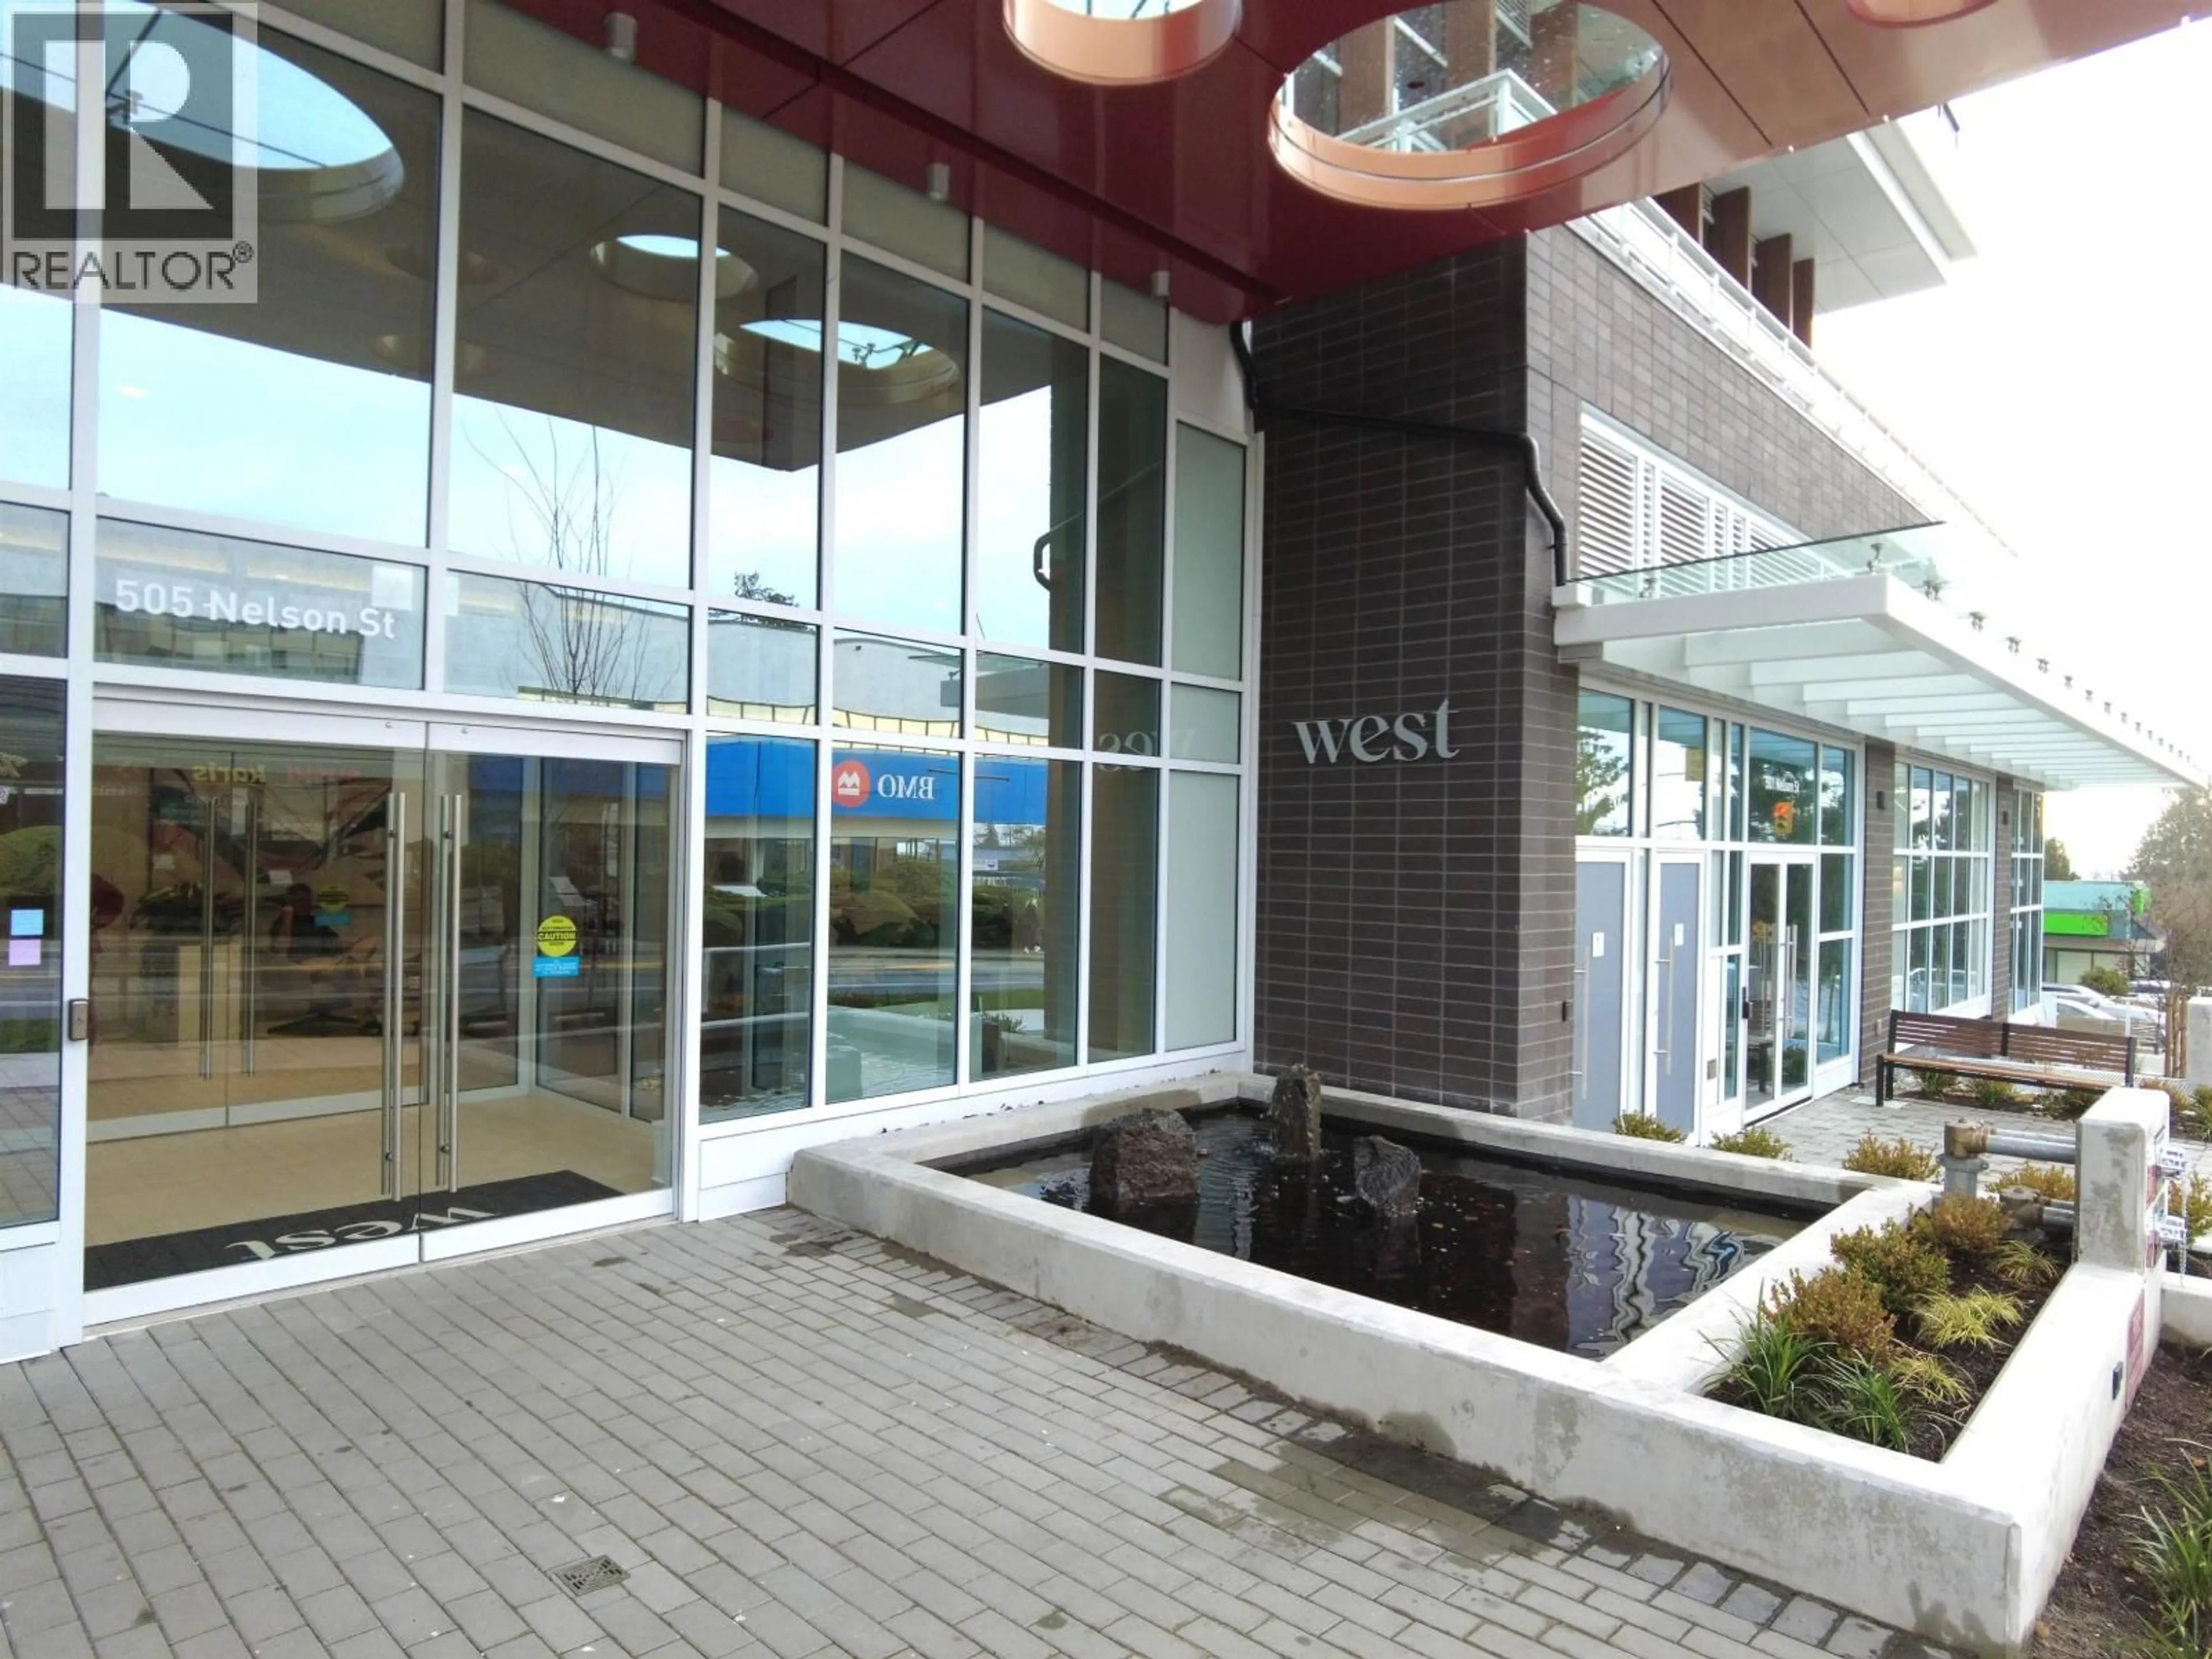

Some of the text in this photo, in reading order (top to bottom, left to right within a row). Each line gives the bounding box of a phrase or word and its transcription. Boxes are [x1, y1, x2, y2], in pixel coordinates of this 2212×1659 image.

[115, 578, 395, 639] 505 Nelson St
[1291, 696, 1461, 764] west
[537, 932, 577, 941] CAUTION
